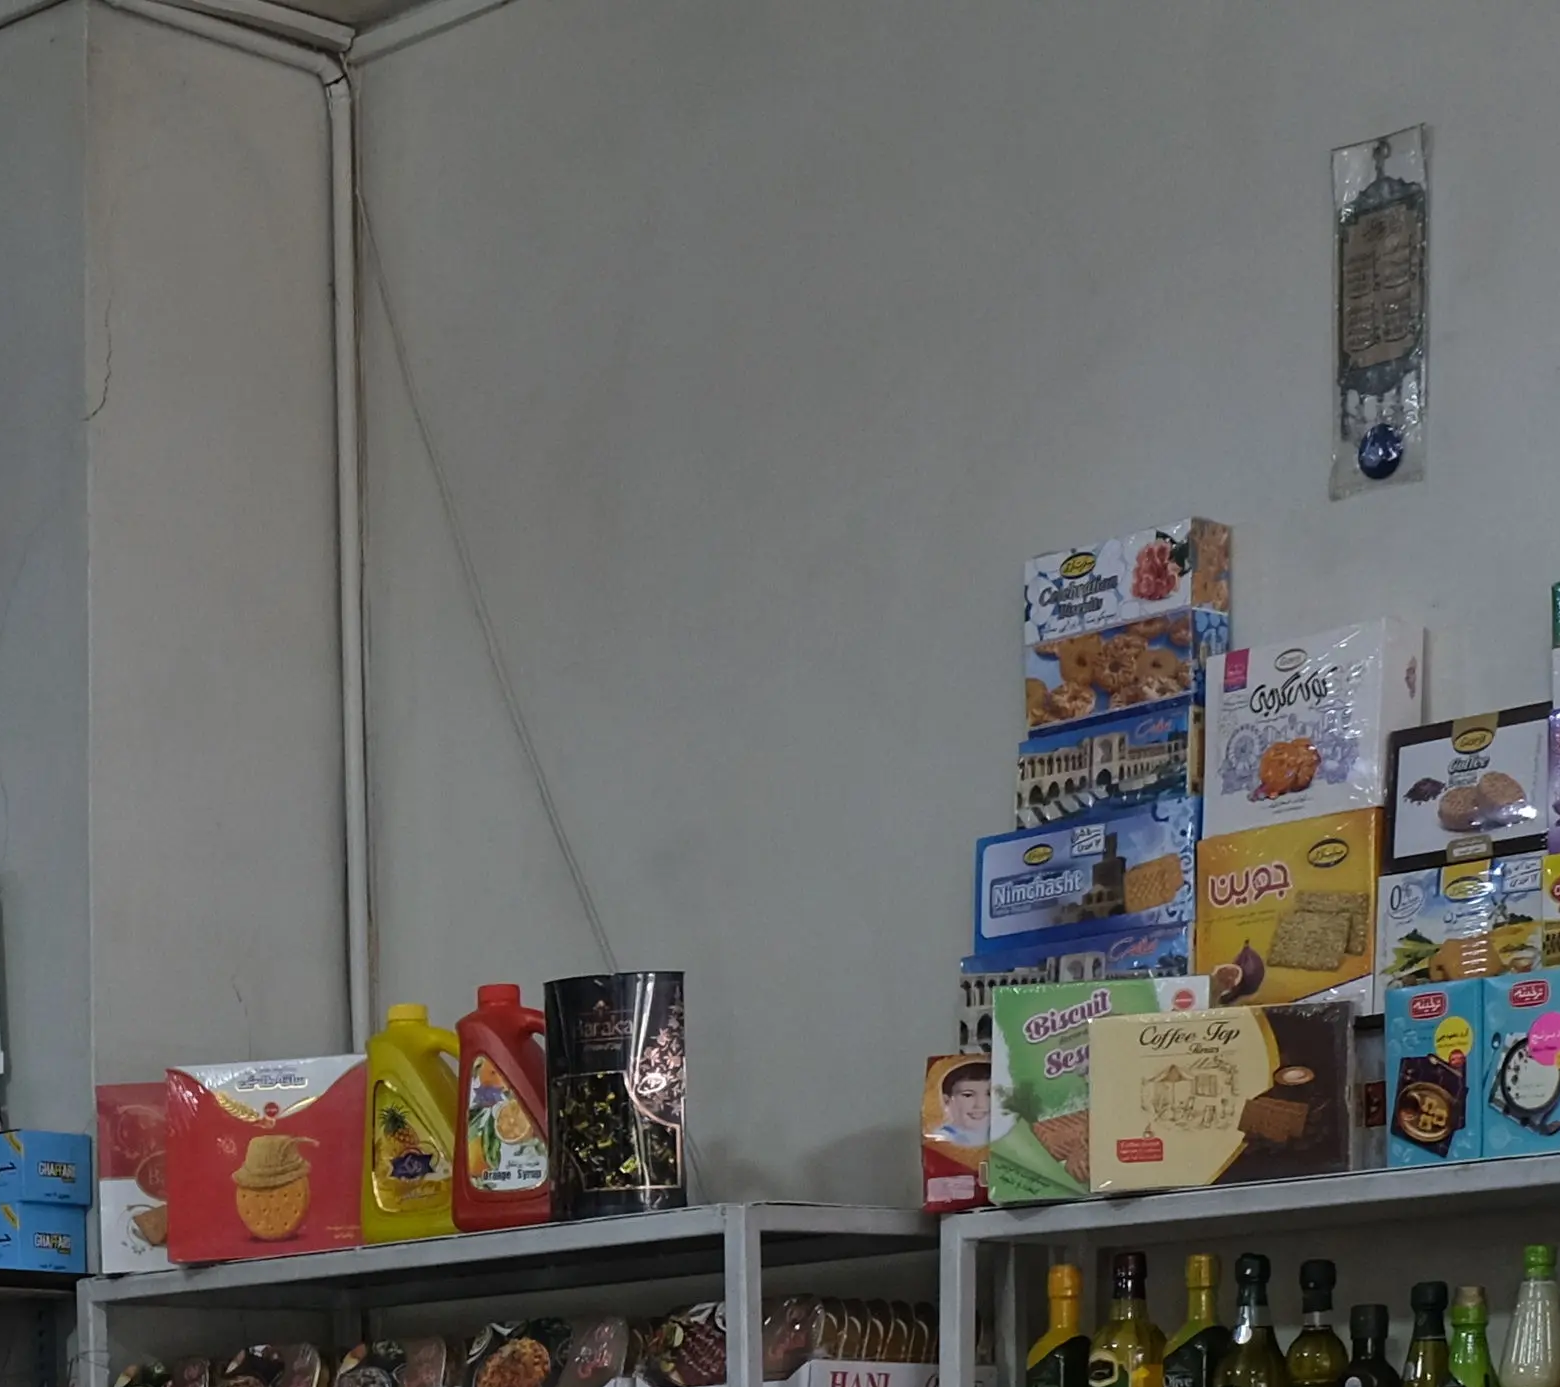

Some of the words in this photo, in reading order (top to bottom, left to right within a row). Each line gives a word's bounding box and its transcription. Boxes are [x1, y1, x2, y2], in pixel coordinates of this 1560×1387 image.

[993, 873, 1083, 908] Nimchasht
[1209, 862, 1293, 906] جوین
[1024, 989, 1112, 1043] Biscuit
[1140, 1021, 1197, 1051] Coffee
[1203, 1021, 1241, 1046] Top
[482, 1169, 512, 1182] Orange
[516, 1167, 543, 1183] Syrup
